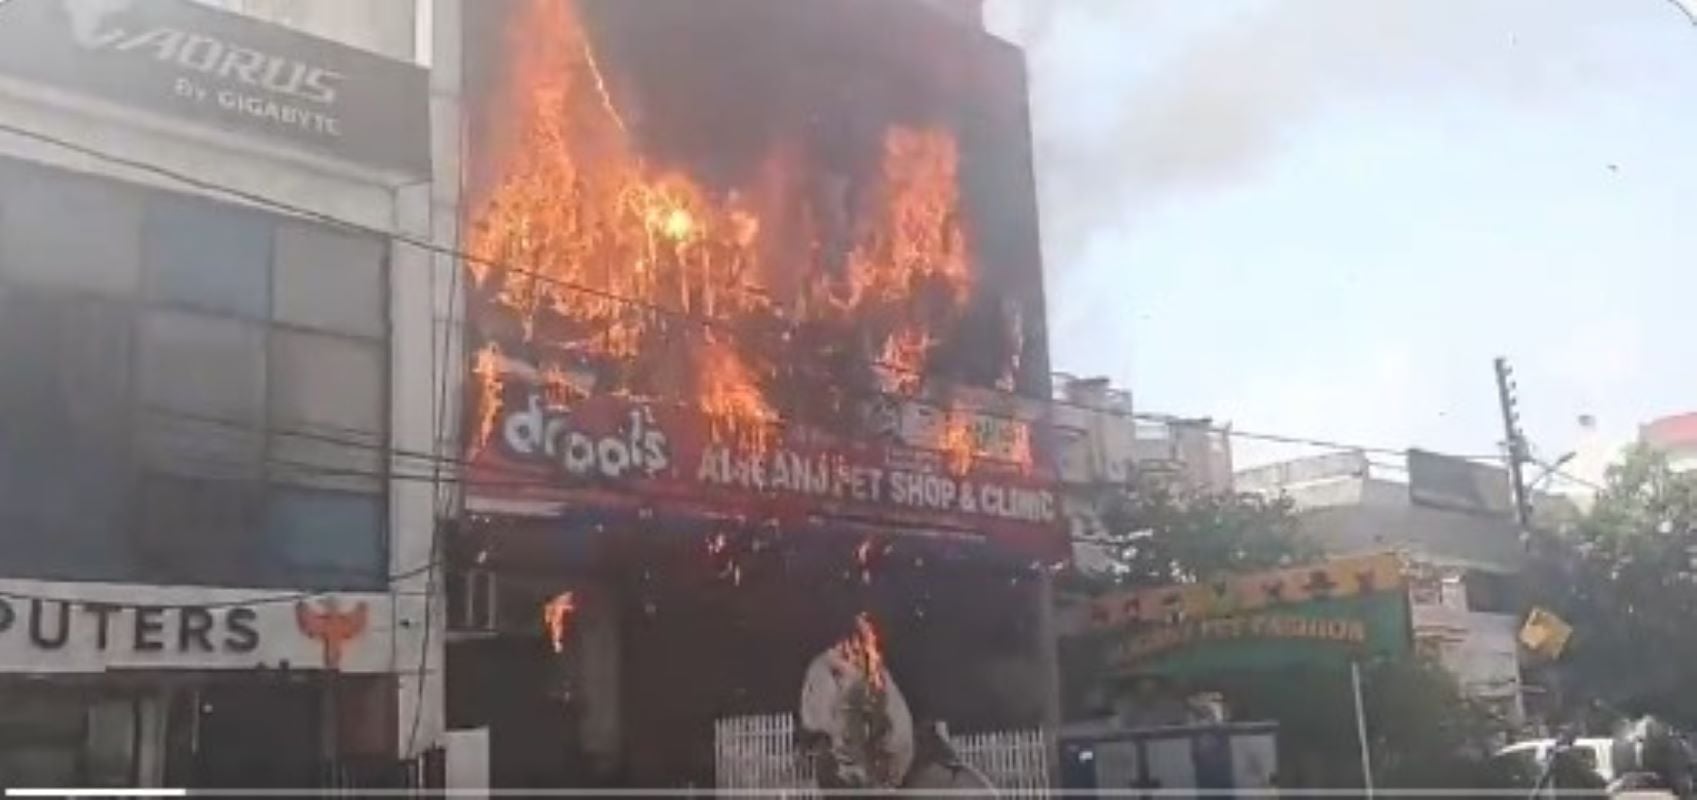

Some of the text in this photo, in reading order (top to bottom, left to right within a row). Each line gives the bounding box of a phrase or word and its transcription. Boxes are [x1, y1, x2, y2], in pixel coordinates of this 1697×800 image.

[115, 27, 350, 104] AORUS
[217, 92, 342, 136] GIGABYTE
[504, 395, 668, 477] drools
[890, 472, 956, 509] SHOP
[959, 481, 977, 512] &
